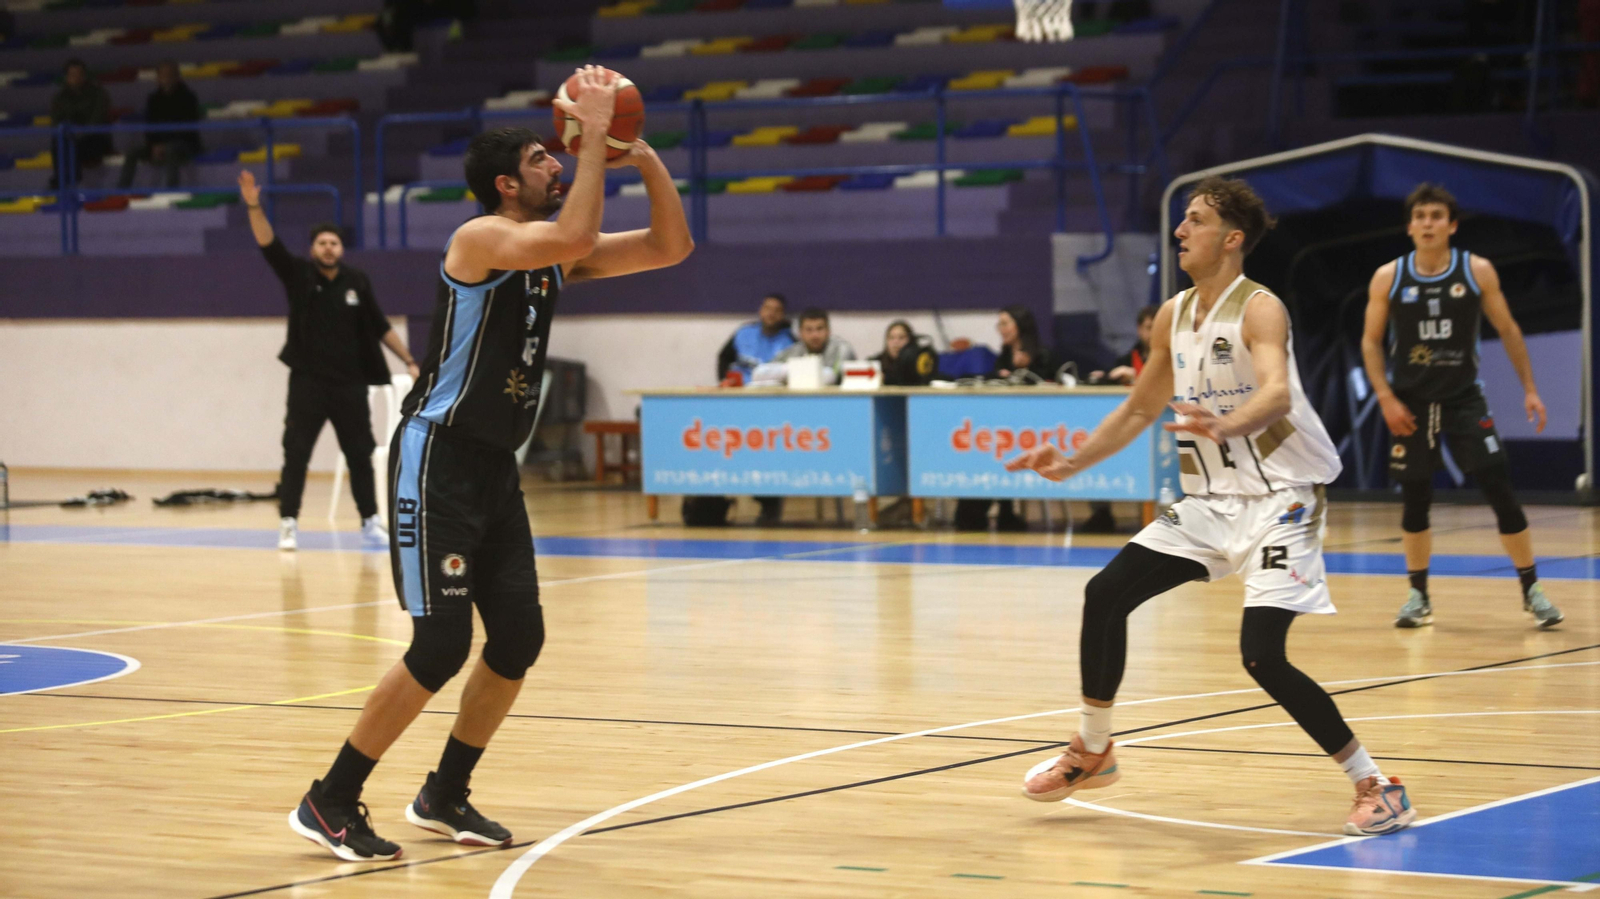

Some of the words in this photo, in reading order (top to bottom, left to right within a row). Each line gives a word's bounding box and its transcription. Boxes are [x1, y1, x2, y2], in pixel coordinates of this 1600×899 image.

[1418, 319, 1452, 340] ULB
[682, 419, 830, 458] deportes
[951, 419, 1091, 460] deporte
[398, 497, 418, 548] ULB
[1262, 545, 1288, 570] 12
[440, 585, 469, 596] vive
